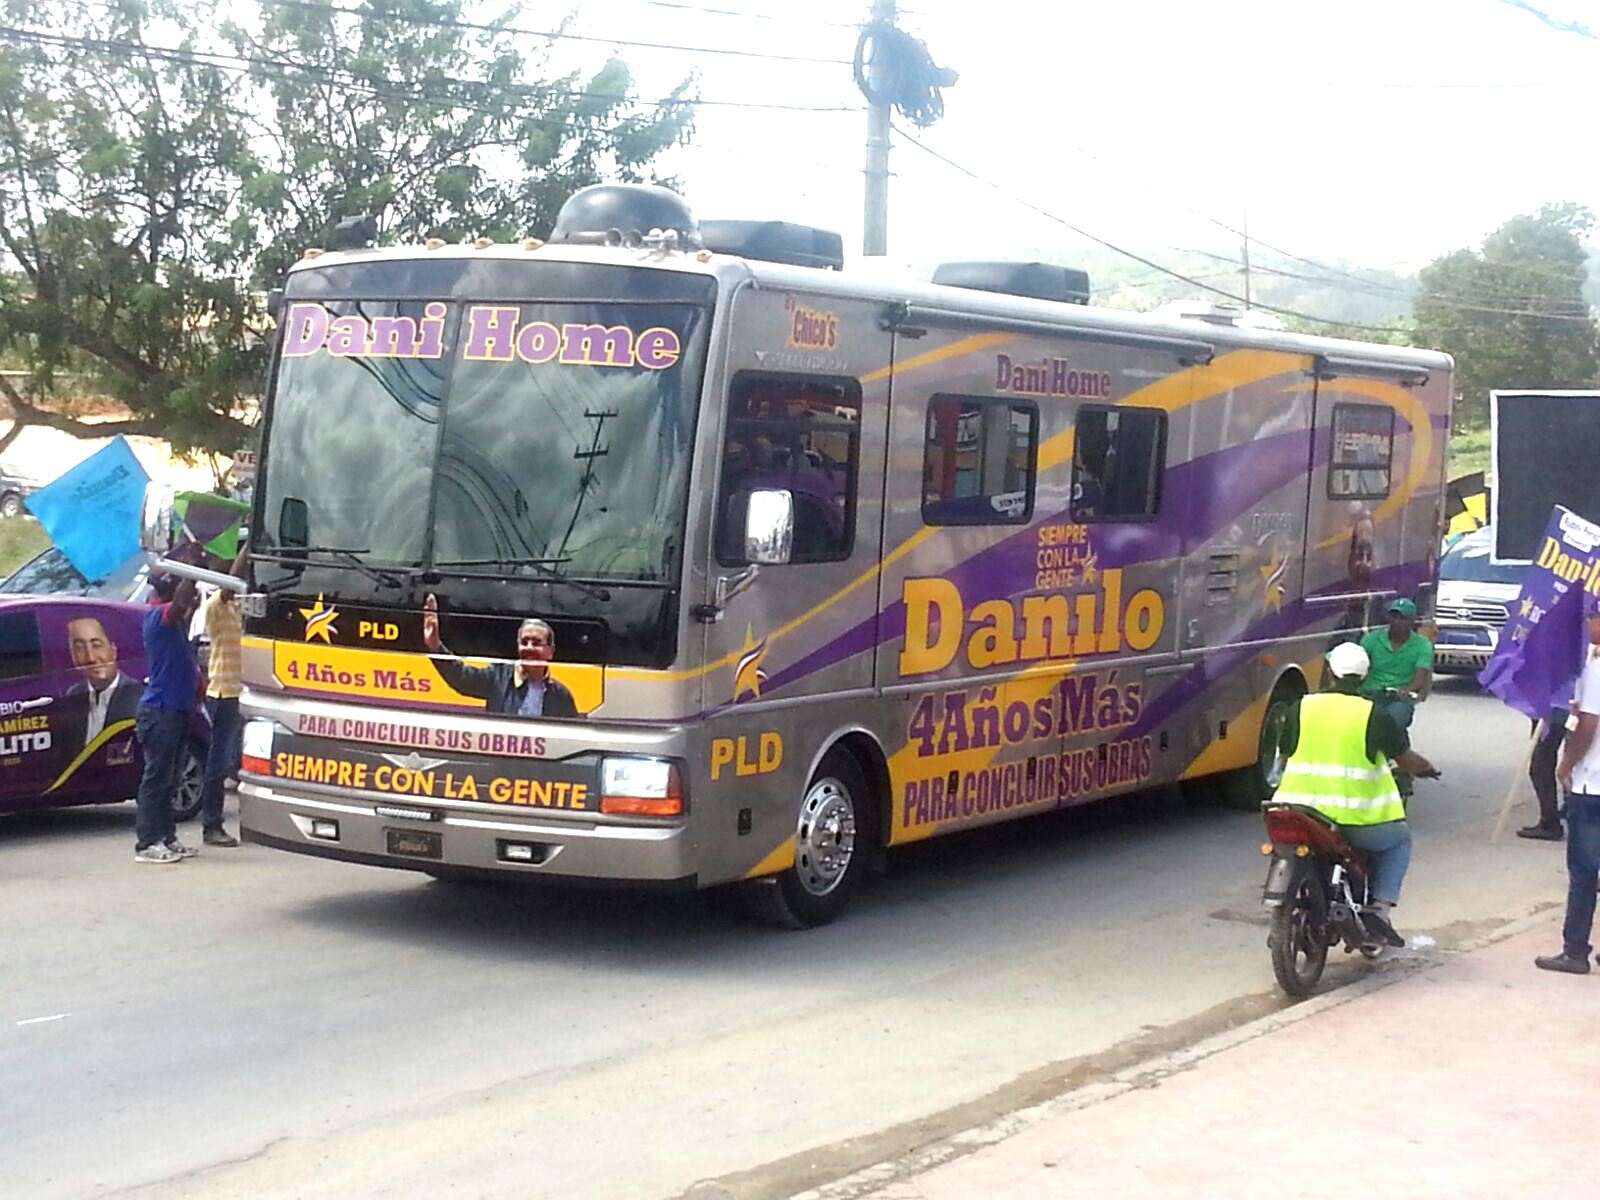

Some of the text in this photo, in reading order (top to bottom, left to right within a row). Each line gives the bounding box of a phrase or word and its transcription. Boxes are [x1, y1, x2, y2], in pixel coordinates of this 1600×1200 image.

[281, 301, 681, 369] Dani Home
[995, 352, 1111, 399] Dani Home
[1036, 547, 1062, 569] CON
[1037, 523, 1088, 547] SIEMPRE
[1035, 568, 1075, 590] GENTE
[358, 621, 399, 640] PLD
[899, 567, 1165, 677] Danilo
[287, 657, 432, 693] 4 Años Más
[299, 714, 547, 756] PARA CONCLUIR SUS OBRAS
[909, 669, 1143, 758] 4 Años Más
[710, 731, 784, 781] PLD
[1058, 751, 1094, 798] SUS
[275, 752, 588, 809] SIEMPRE CON LA GENTE
